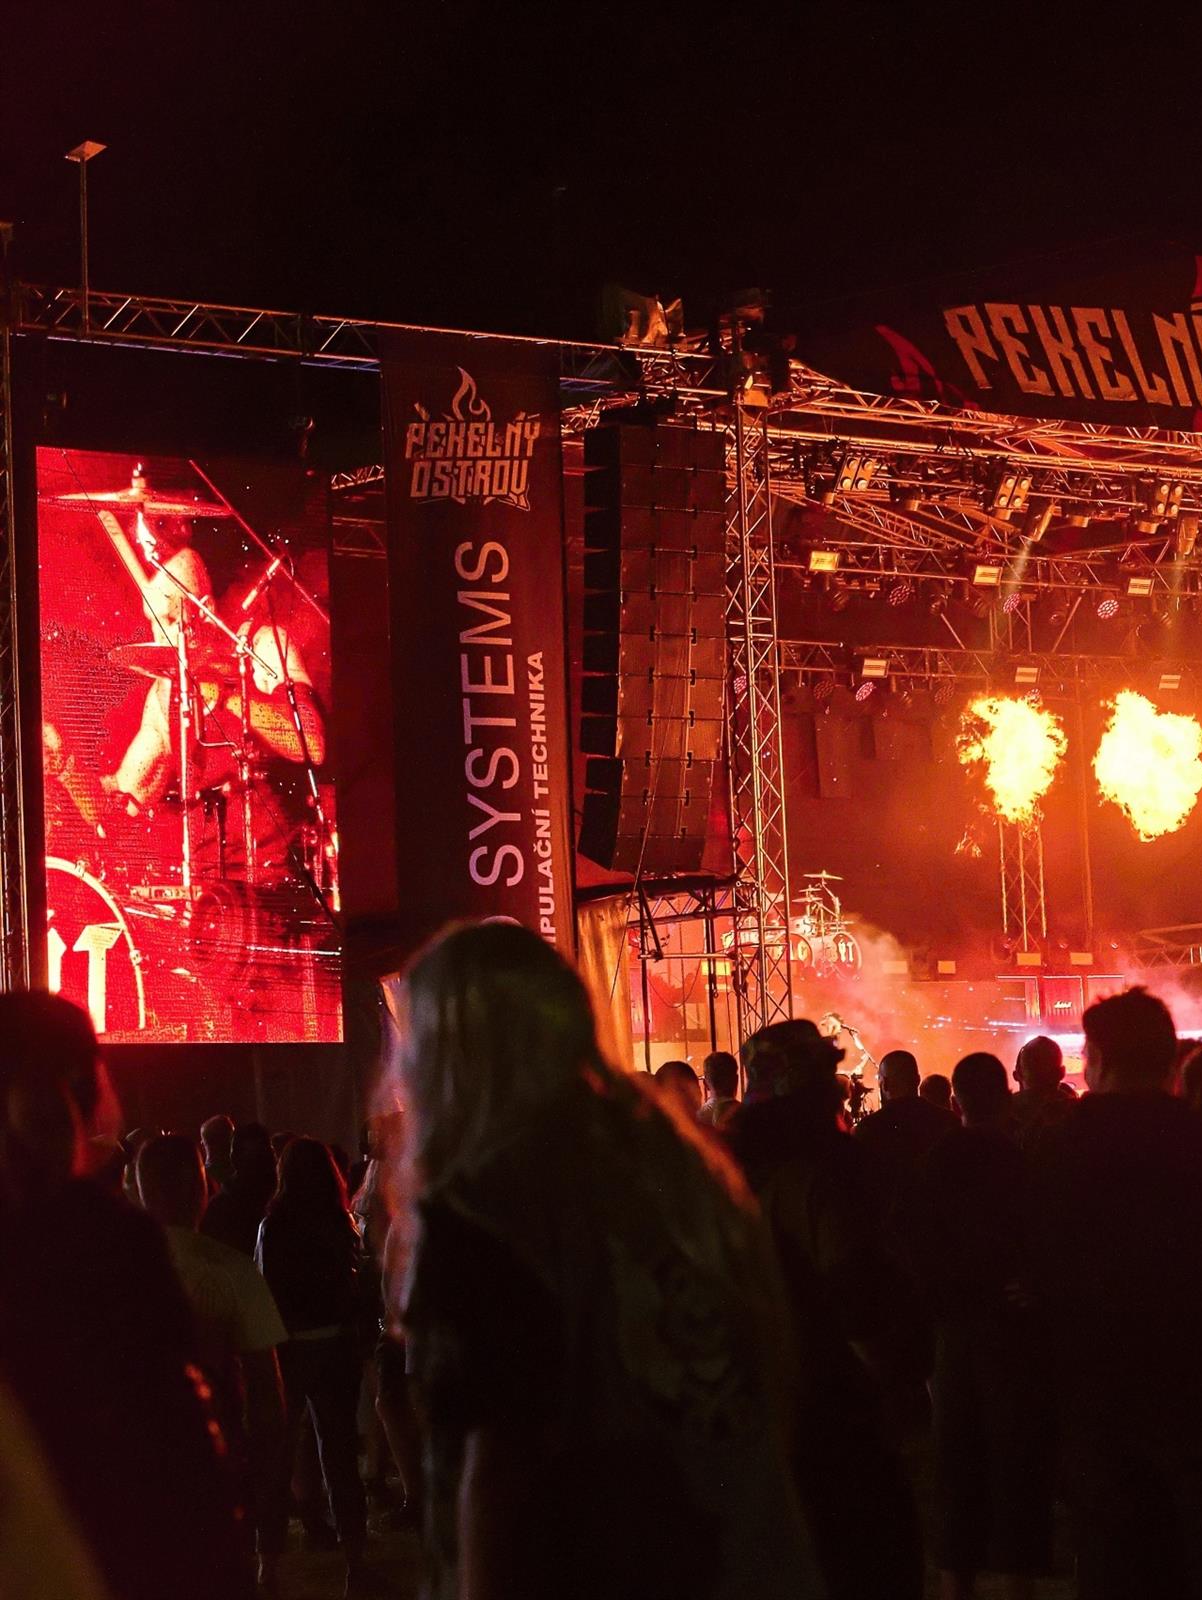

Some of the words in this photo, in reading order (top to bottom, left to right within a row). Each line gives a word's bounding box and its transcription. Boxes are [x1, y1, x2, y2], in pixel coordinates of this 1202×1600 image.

[454, 541, 525, 887] SYSTEMS
[527, 651, 550, 800] TECHNIKA
[531, 808, 557, 944] IPULAČNÍ
